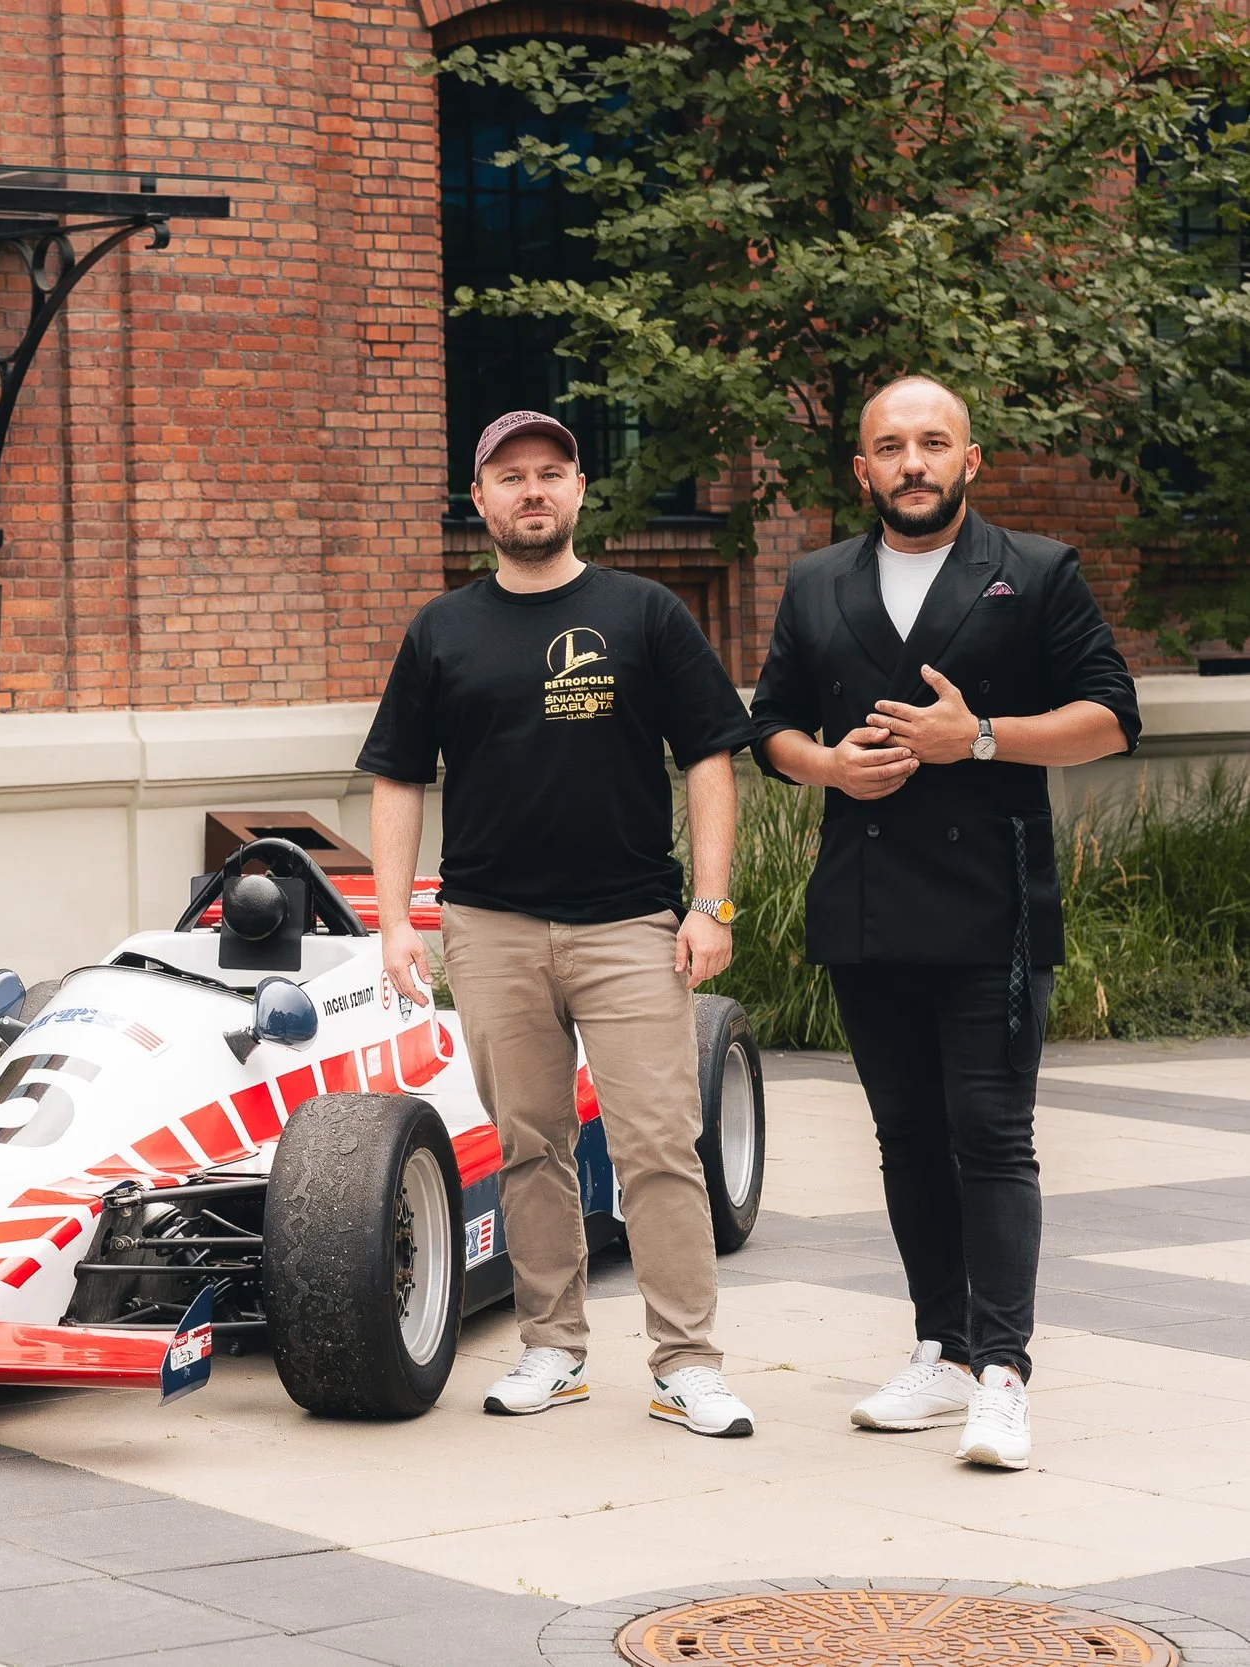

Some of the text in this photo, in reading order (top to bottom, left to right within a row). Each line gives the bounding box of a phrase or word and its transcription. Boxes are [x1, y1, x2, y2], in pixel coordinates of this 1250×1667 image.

[545, 676, 614, 690] RETROPOLIS
[544, 692, 615, 705] ŚNIADANIE
[566, 712, 596, 720] CLASSIC
[349, 986, 375, 1009] SZMIDT
